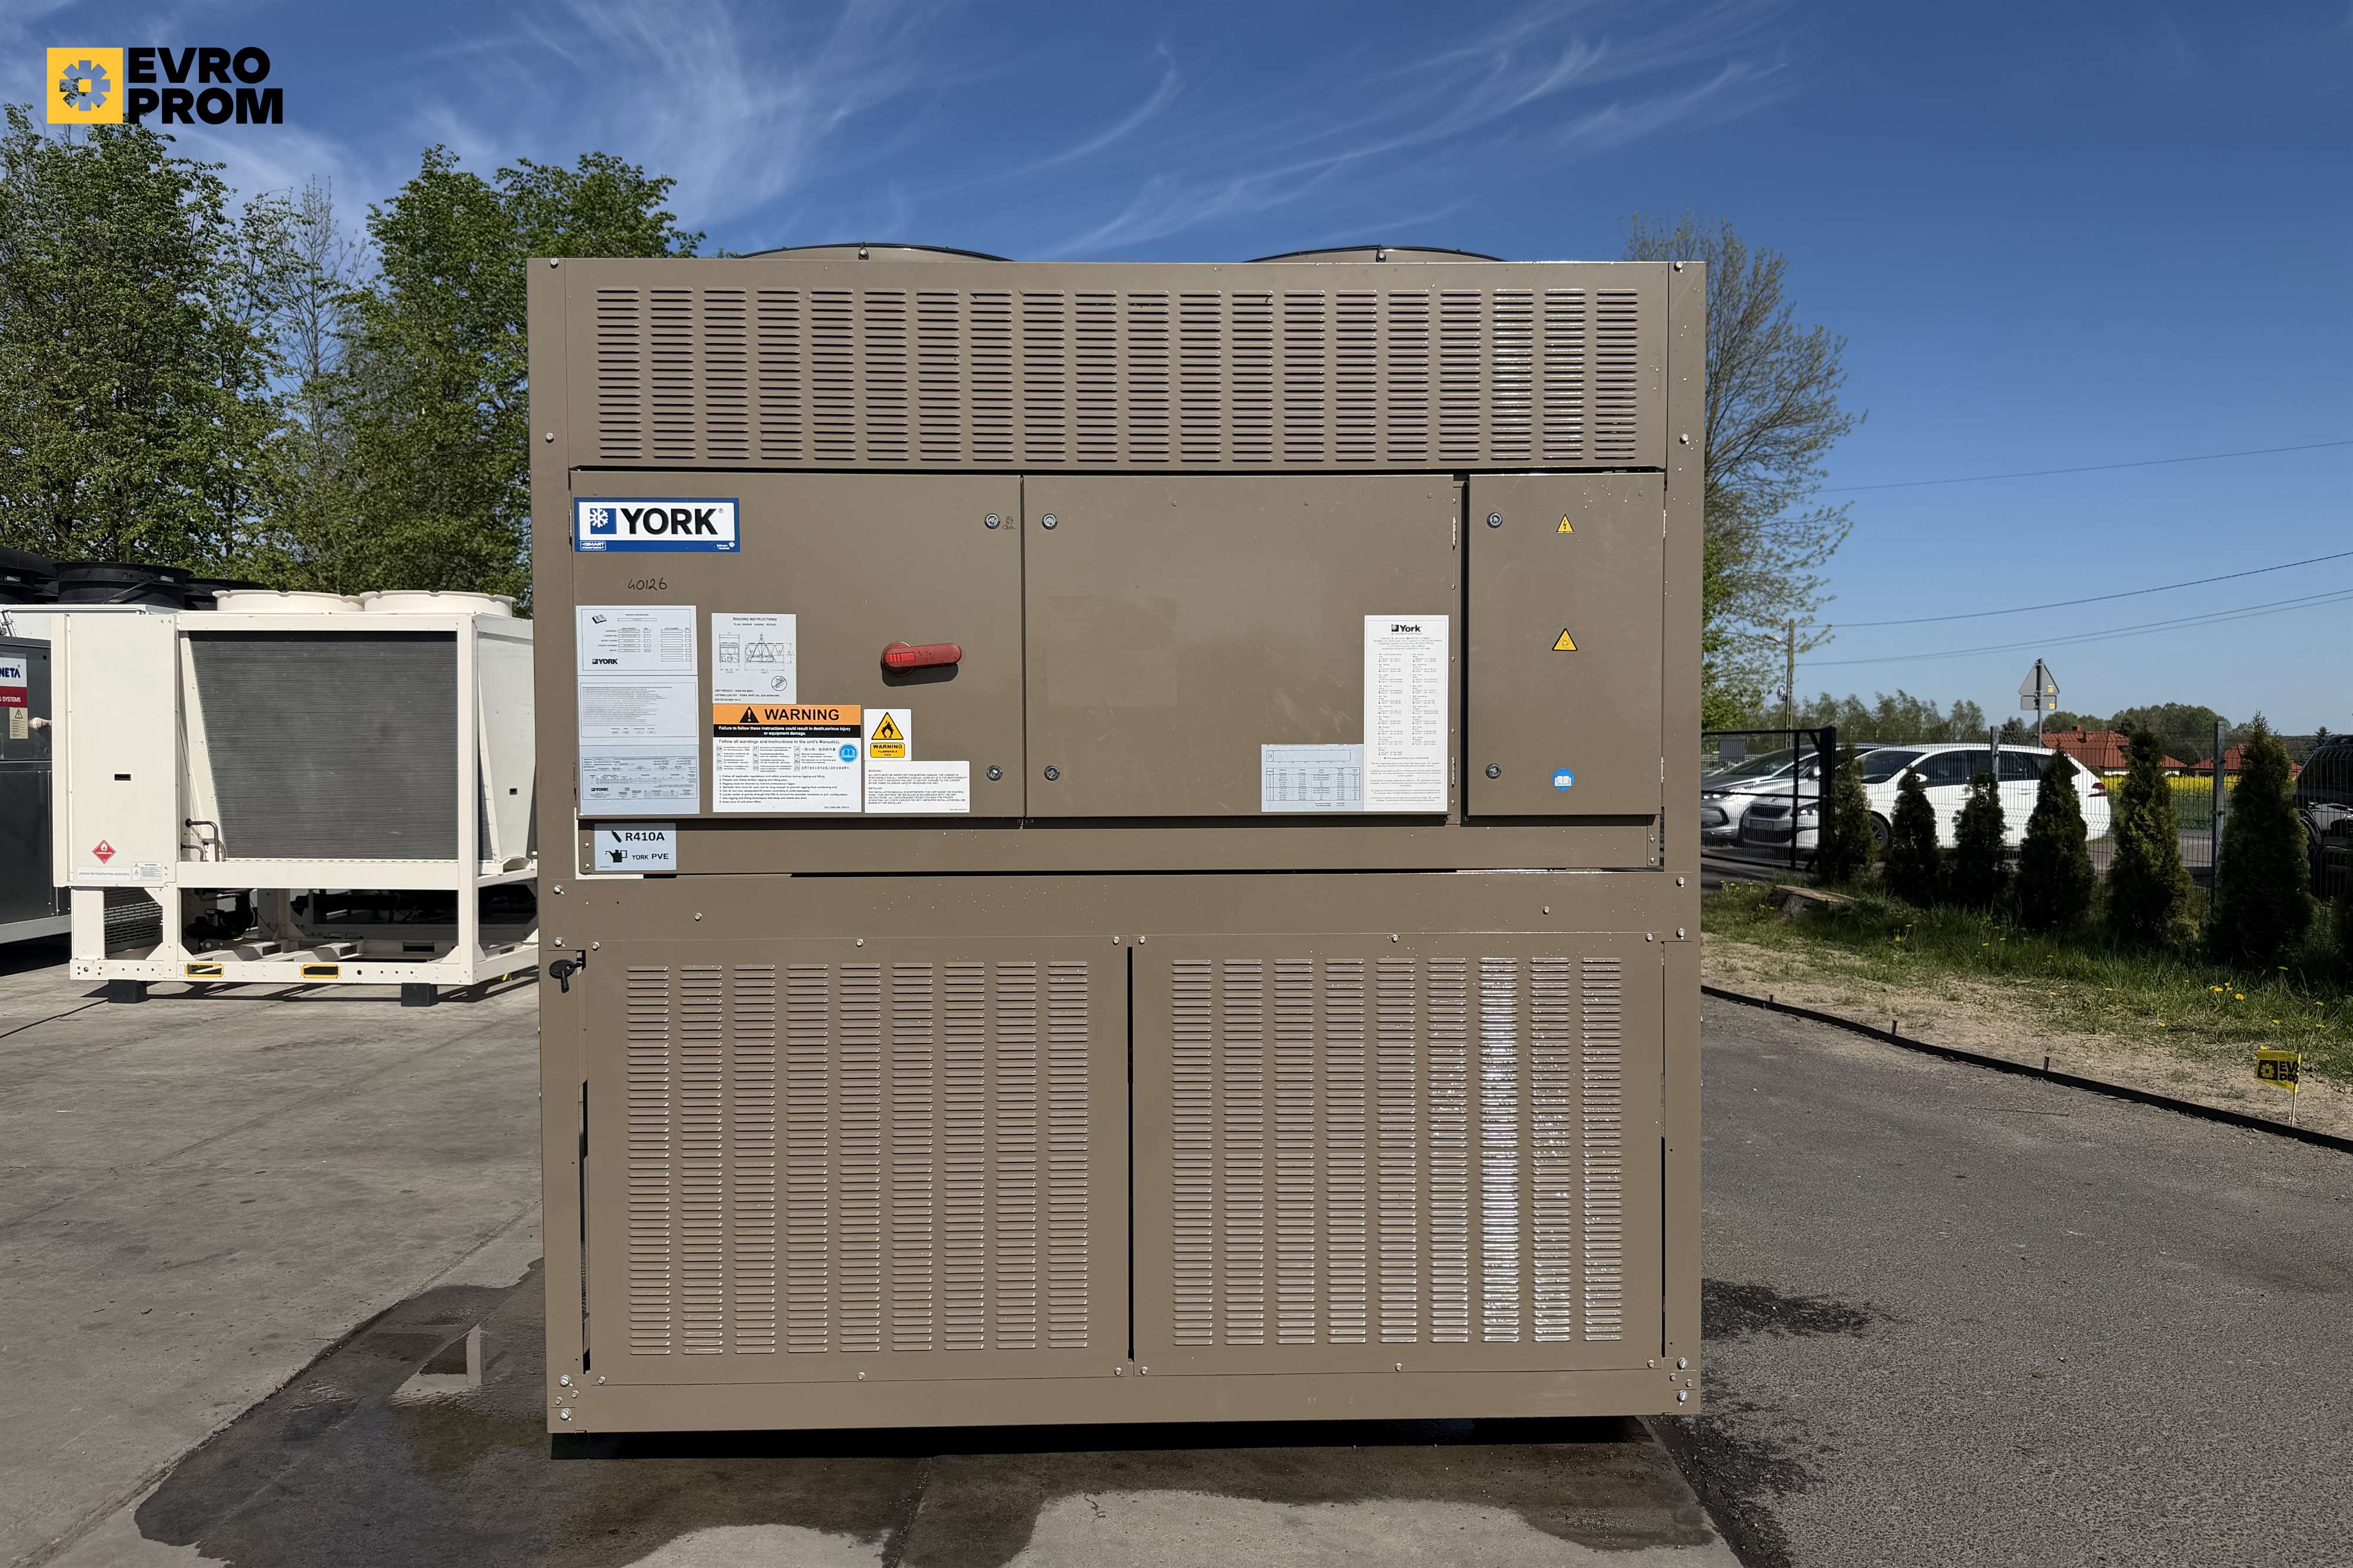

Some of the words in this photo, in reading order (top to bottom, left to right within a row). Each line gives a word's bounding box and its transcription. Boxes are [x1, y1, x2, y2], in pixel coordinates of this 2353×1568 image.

[620, 508, 719, 535] YORK
[628, 577, 667, 591] 40126
[765, 709, 839, 721] WARNING
[626, 832, 665, 841] R410A
